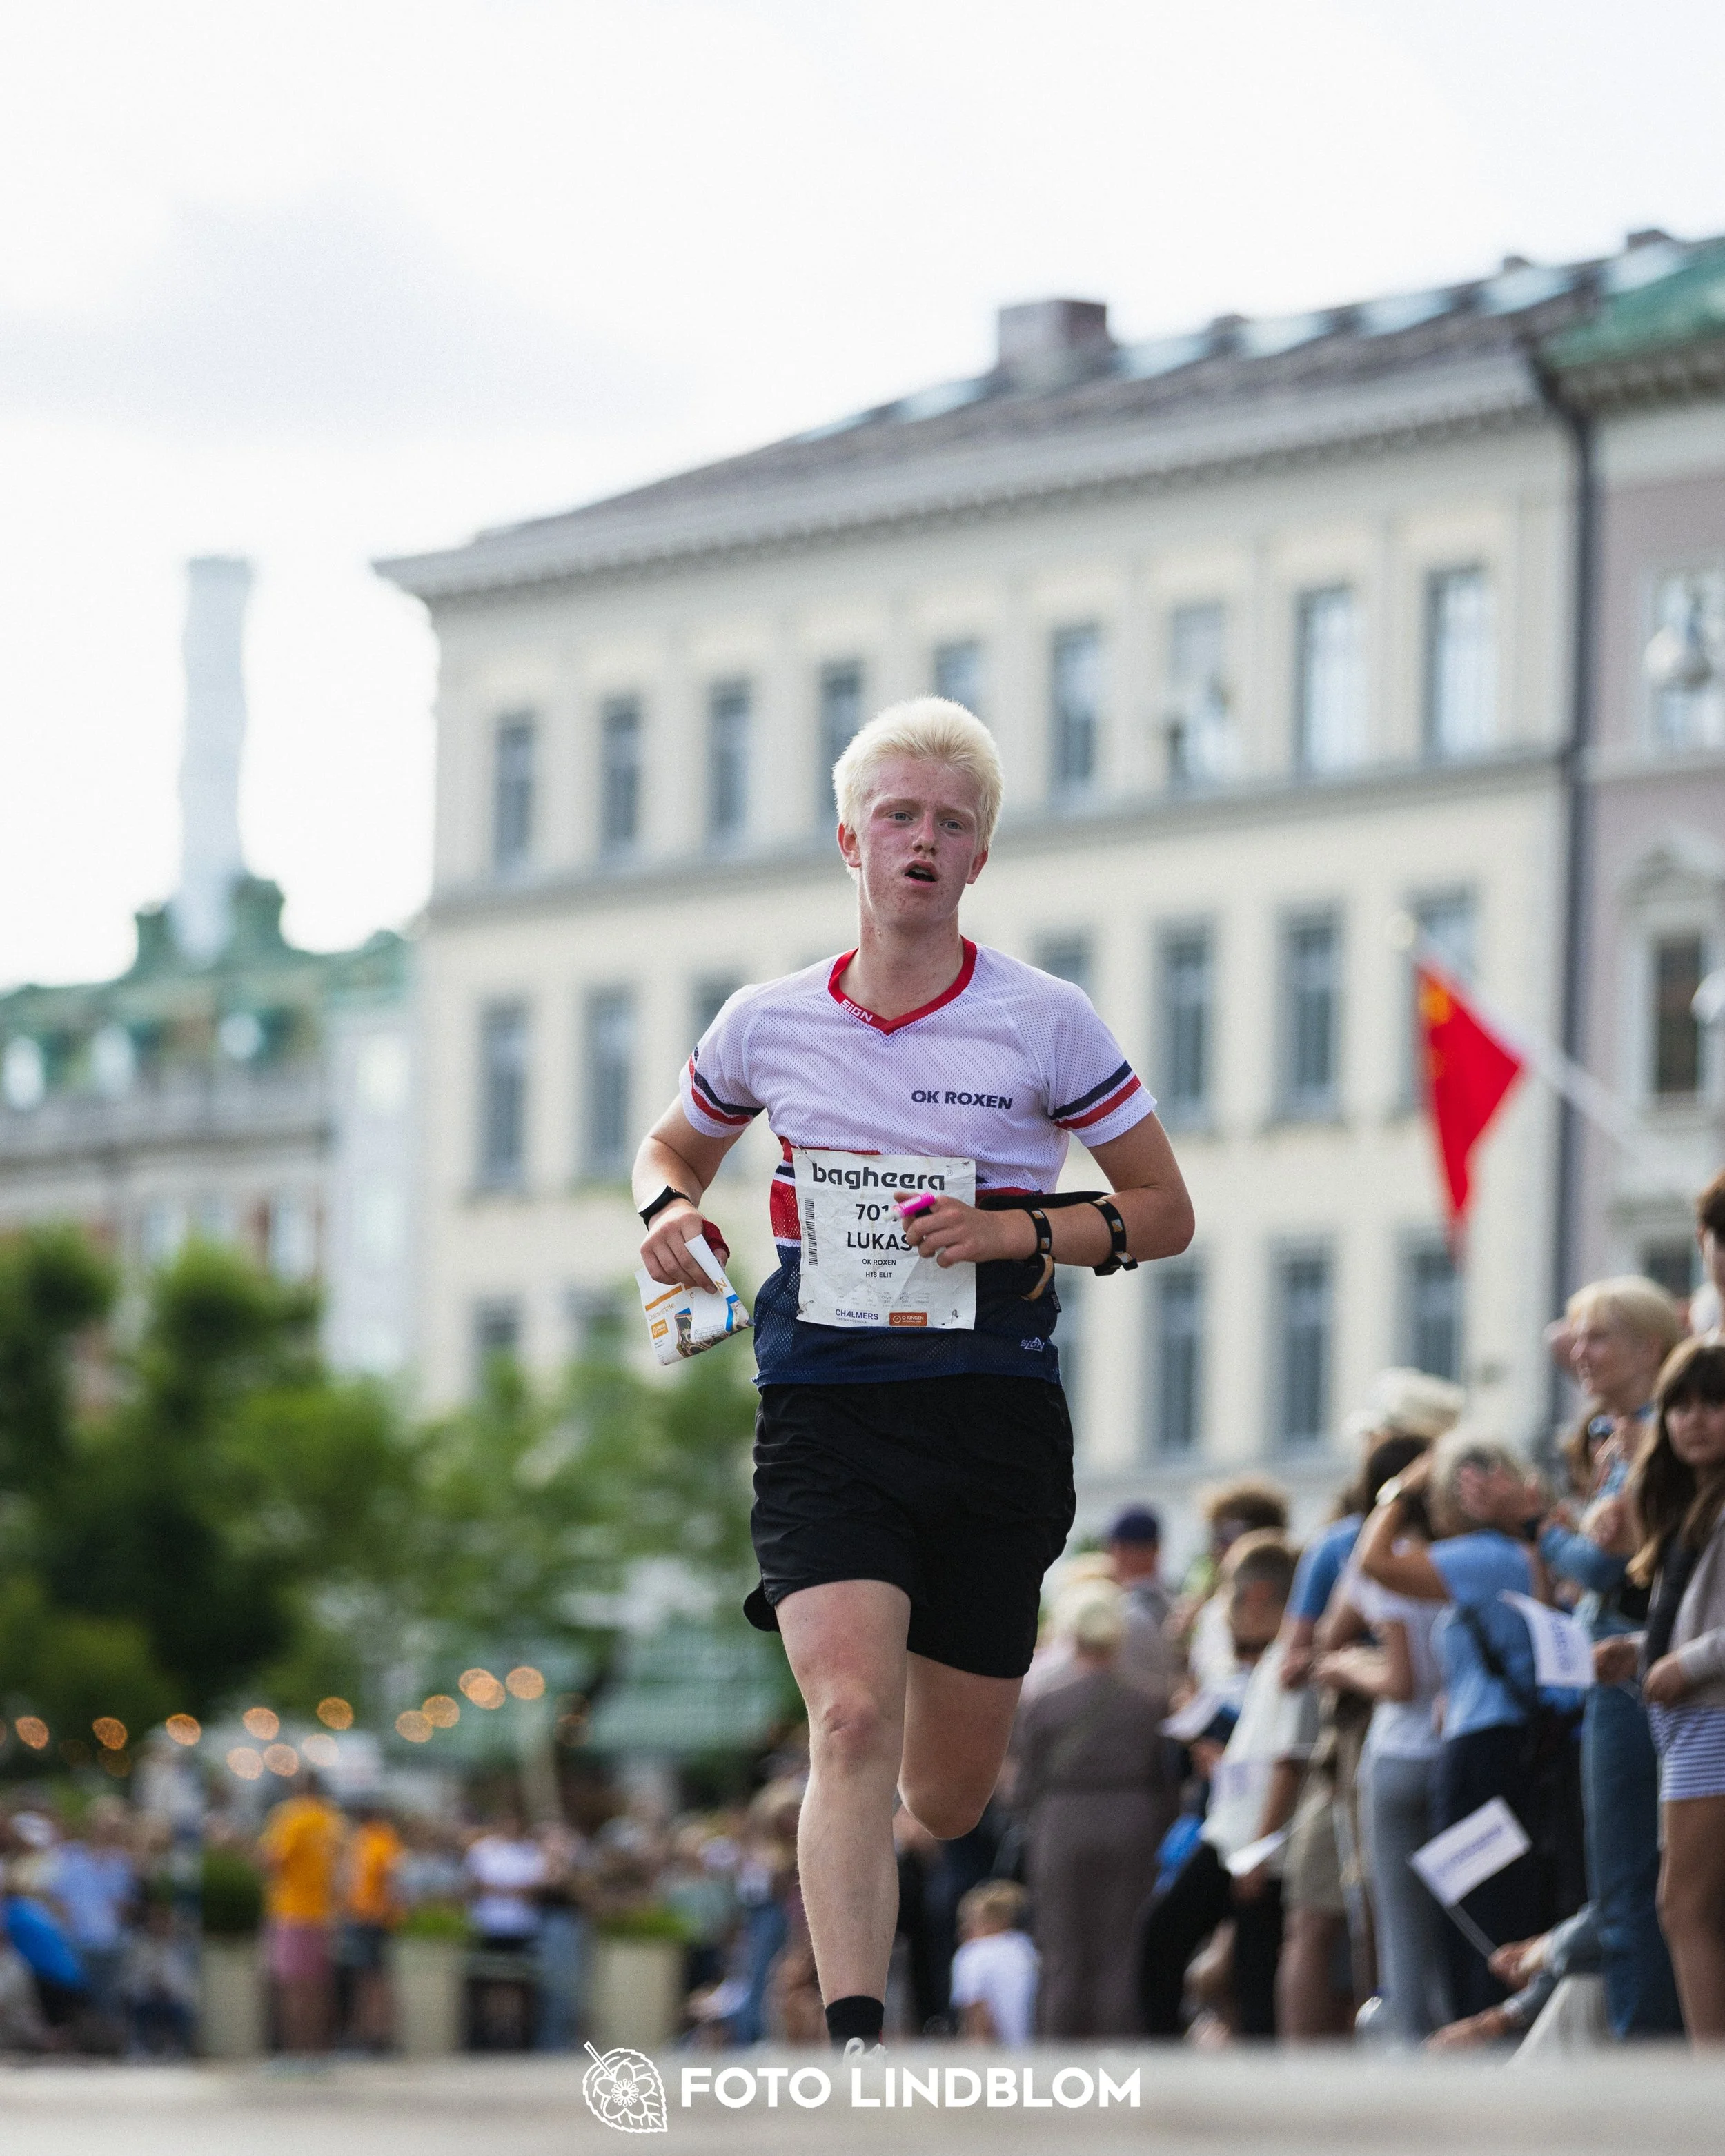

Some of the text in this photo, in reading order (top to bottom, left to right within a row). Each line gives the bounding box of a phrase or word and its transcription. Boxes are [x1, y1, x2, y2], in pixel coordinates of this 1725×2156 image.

[911, 1090, 1013, 1109] OK ROXEN
[813, 1163, 945, 1190] bagheera
[847, 1232, 913, 1251] LUKAS
[835, 1309, 879, 1320] CHALMERS
